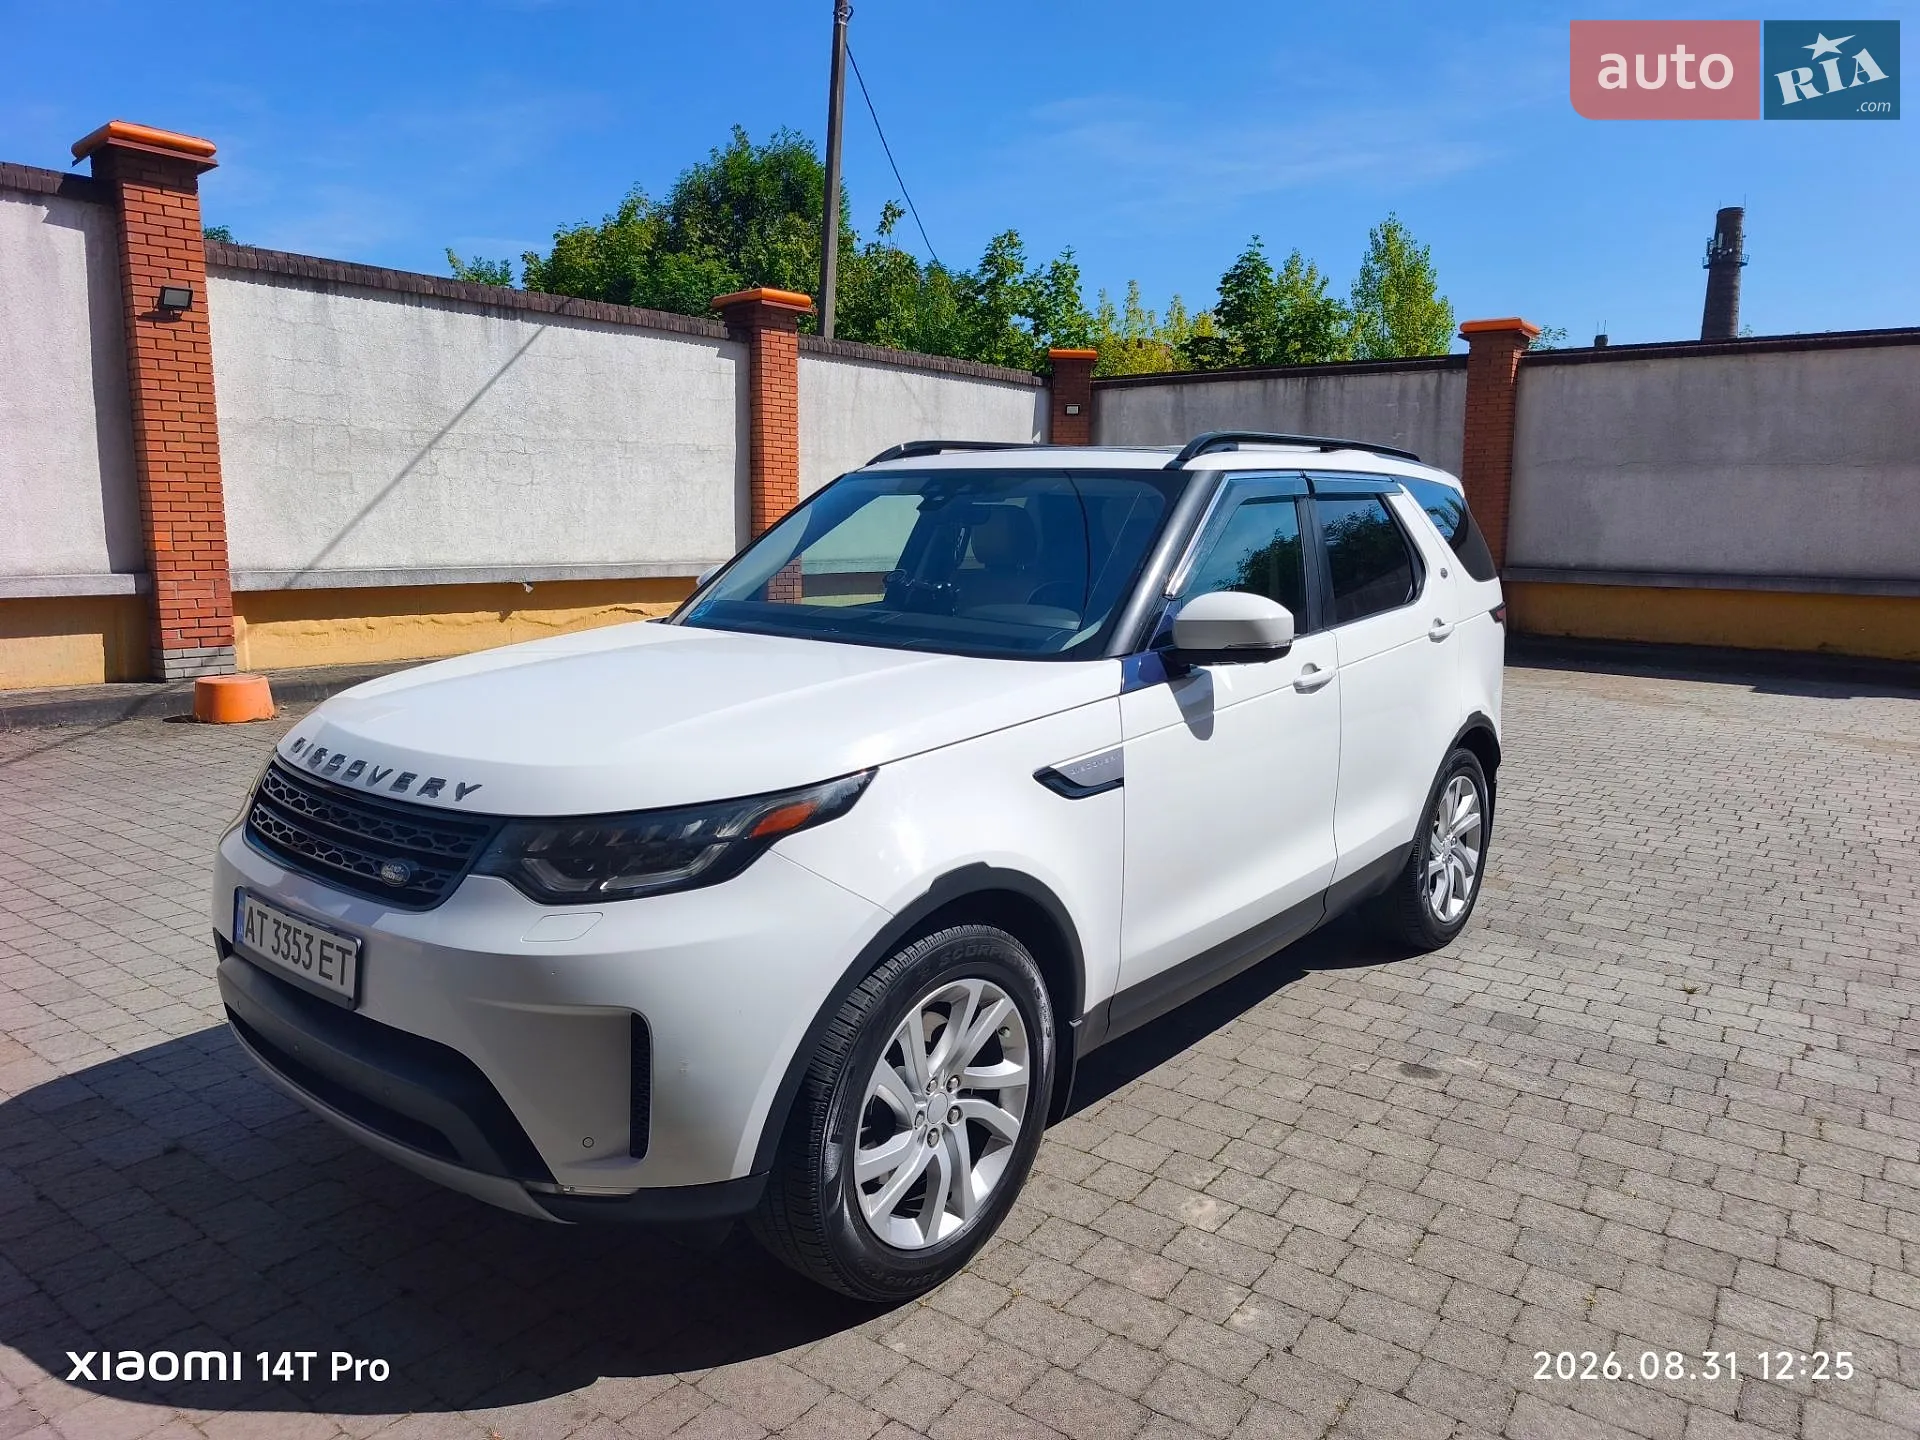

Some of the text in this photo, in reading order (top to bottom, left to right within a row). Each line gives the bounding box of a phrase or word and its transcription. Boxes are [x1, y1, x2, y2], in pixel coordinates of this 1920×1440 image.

[290, 737, 483, 802] DISCOVERY
[245, 906, 353, 986] AT 3353 ET
